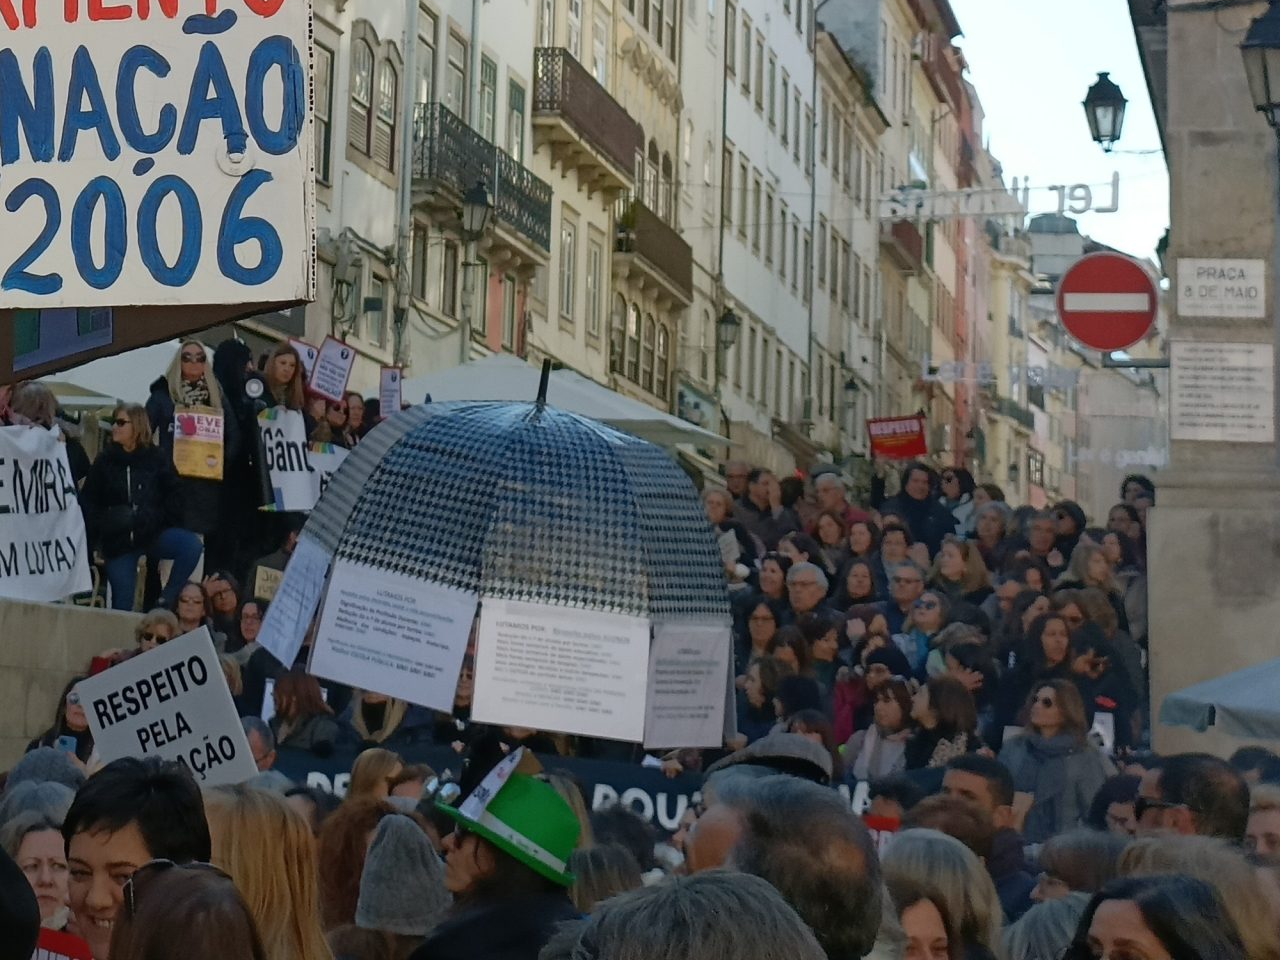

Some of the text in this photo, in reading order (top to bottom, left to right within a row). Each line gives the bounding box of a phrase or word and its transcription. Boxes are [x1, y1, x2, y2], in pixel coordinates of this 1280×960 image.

[1184, 285, 1258, 299] 8 DE MAIO
[93, 655, 208, 730] RESPEITO
[136, 711, 192, 753] PELA
